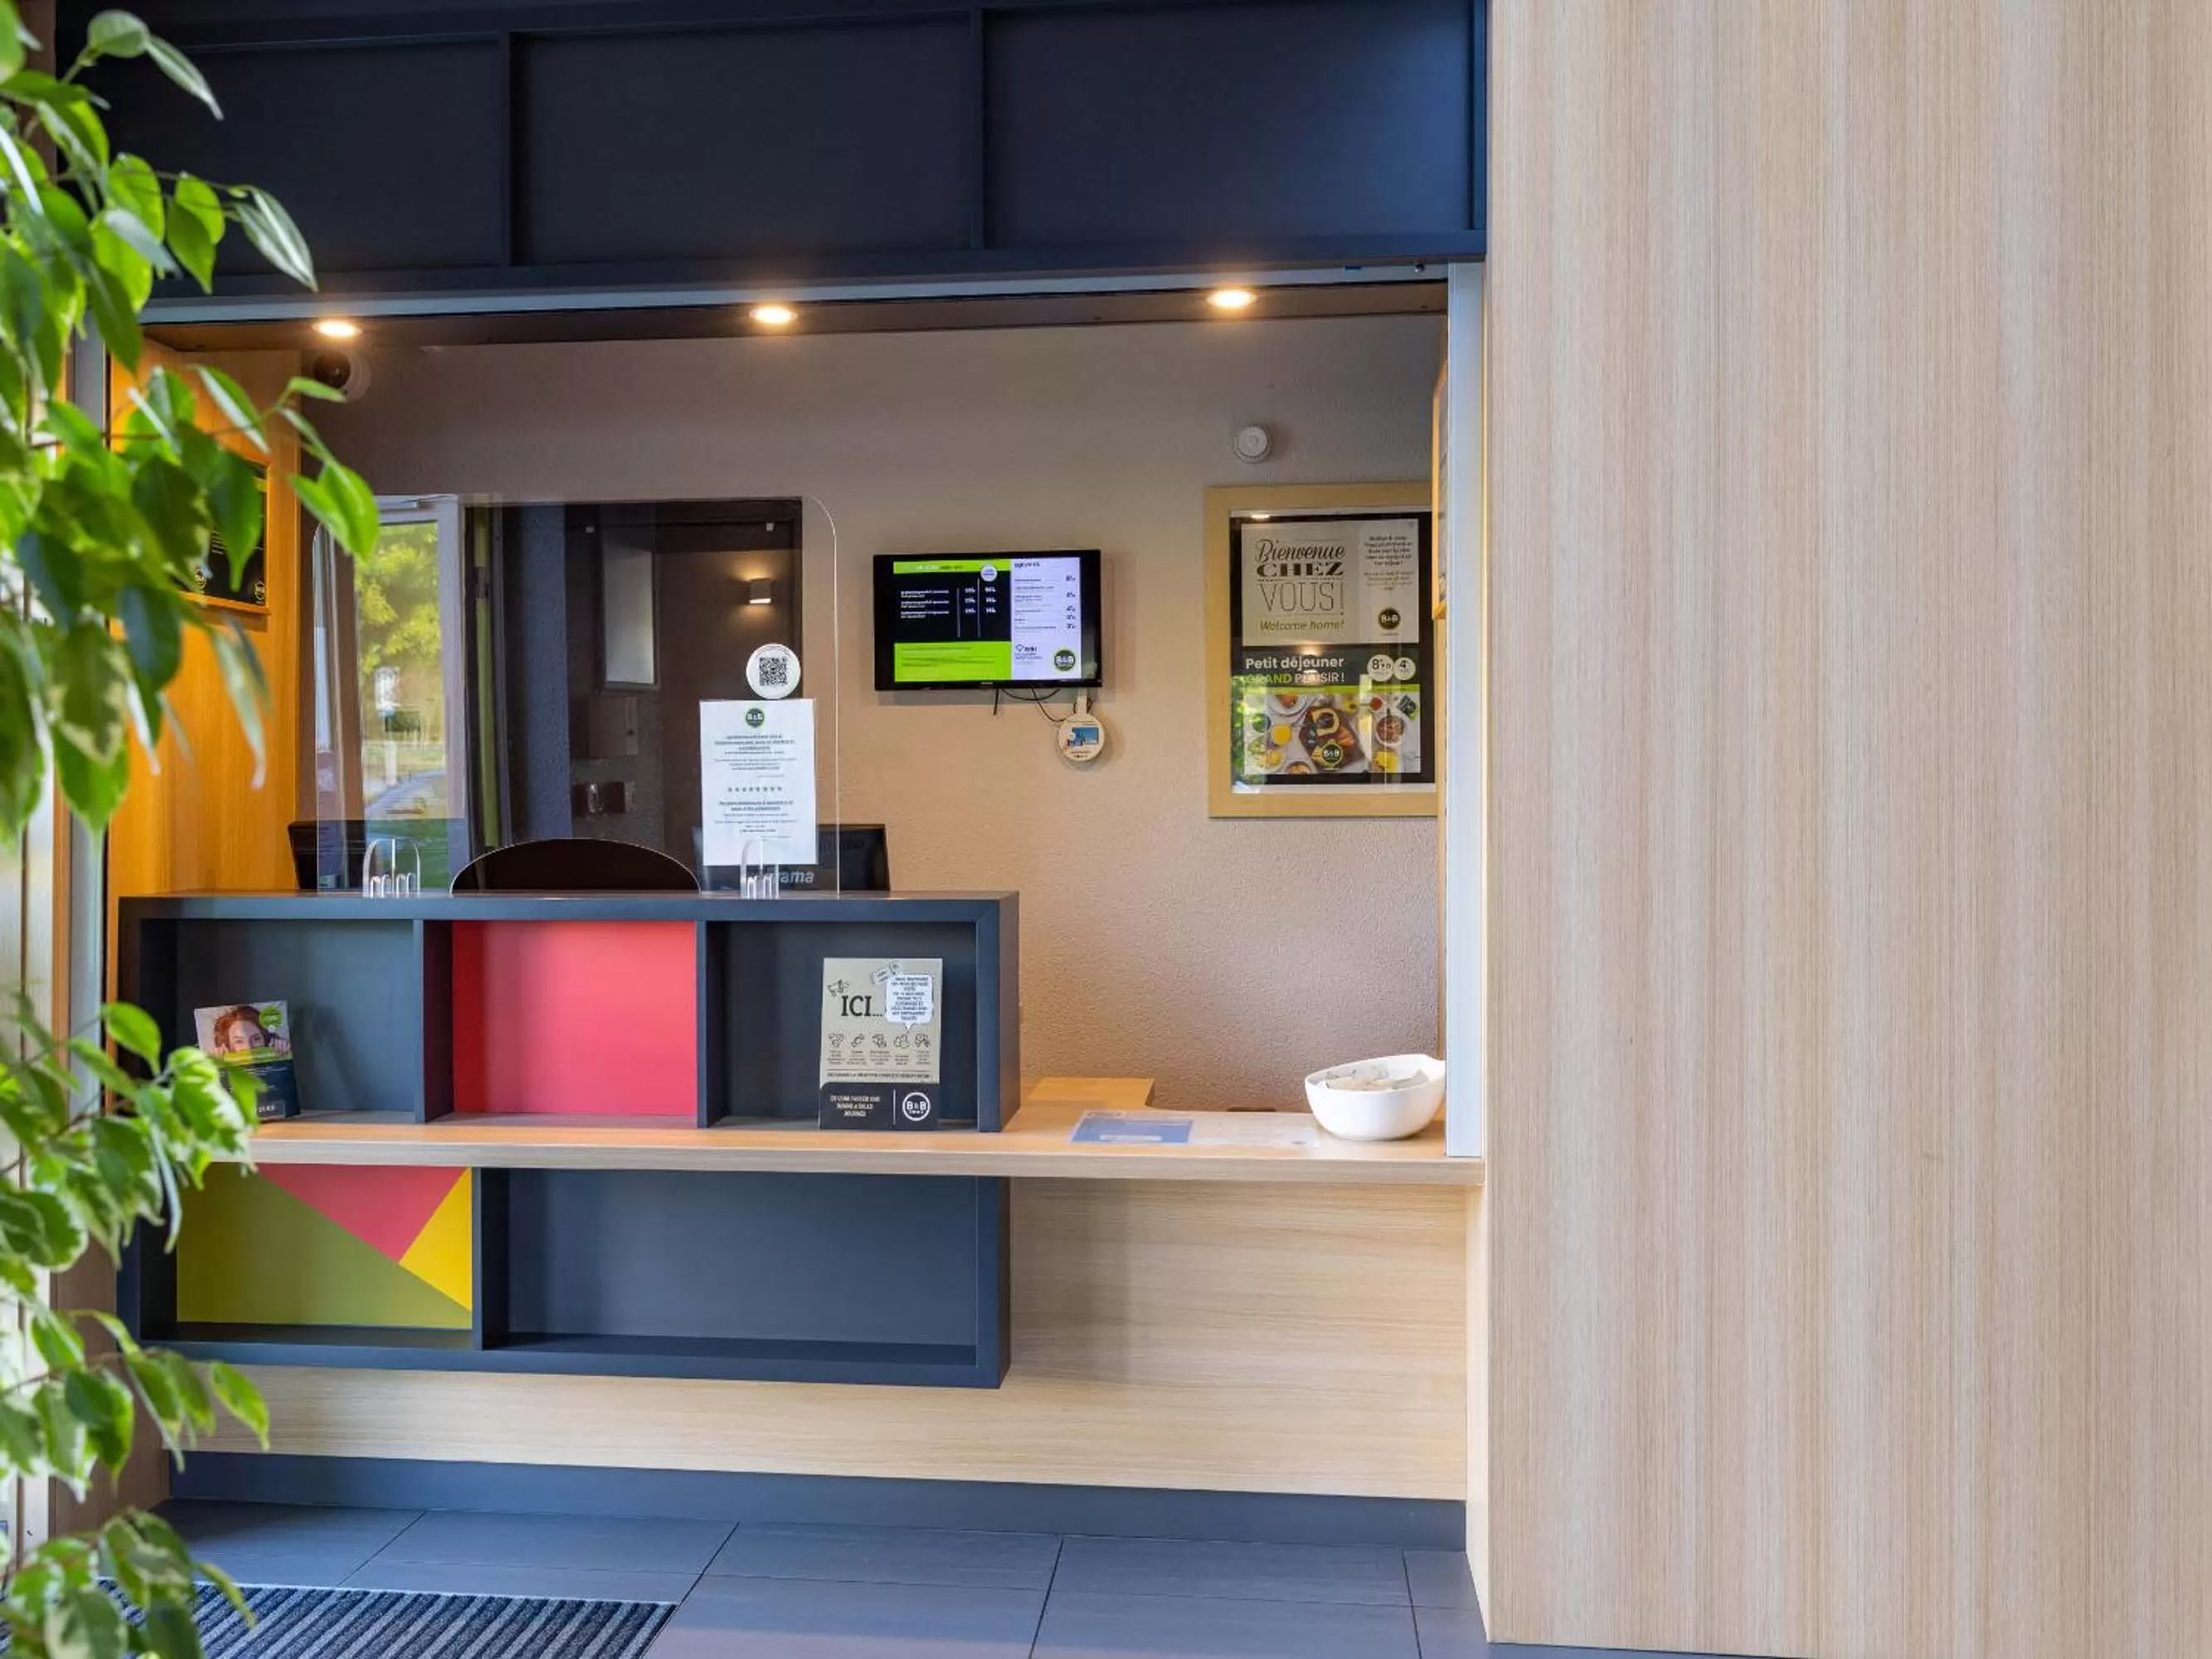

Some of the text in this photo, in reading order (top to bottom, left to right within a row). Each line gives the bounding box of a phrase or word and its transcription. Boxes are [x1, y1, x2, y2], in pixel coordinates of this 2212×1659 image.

[1255, 539, 1345, 563] Bienvenue
[1257, 562, 1344, 577] CHEZ
[1245, 655, 1344, 671] Petit déjeuner
[1247, 673, 1293, 684] GRAND
[906, 1101, 927, 1111] B&B
